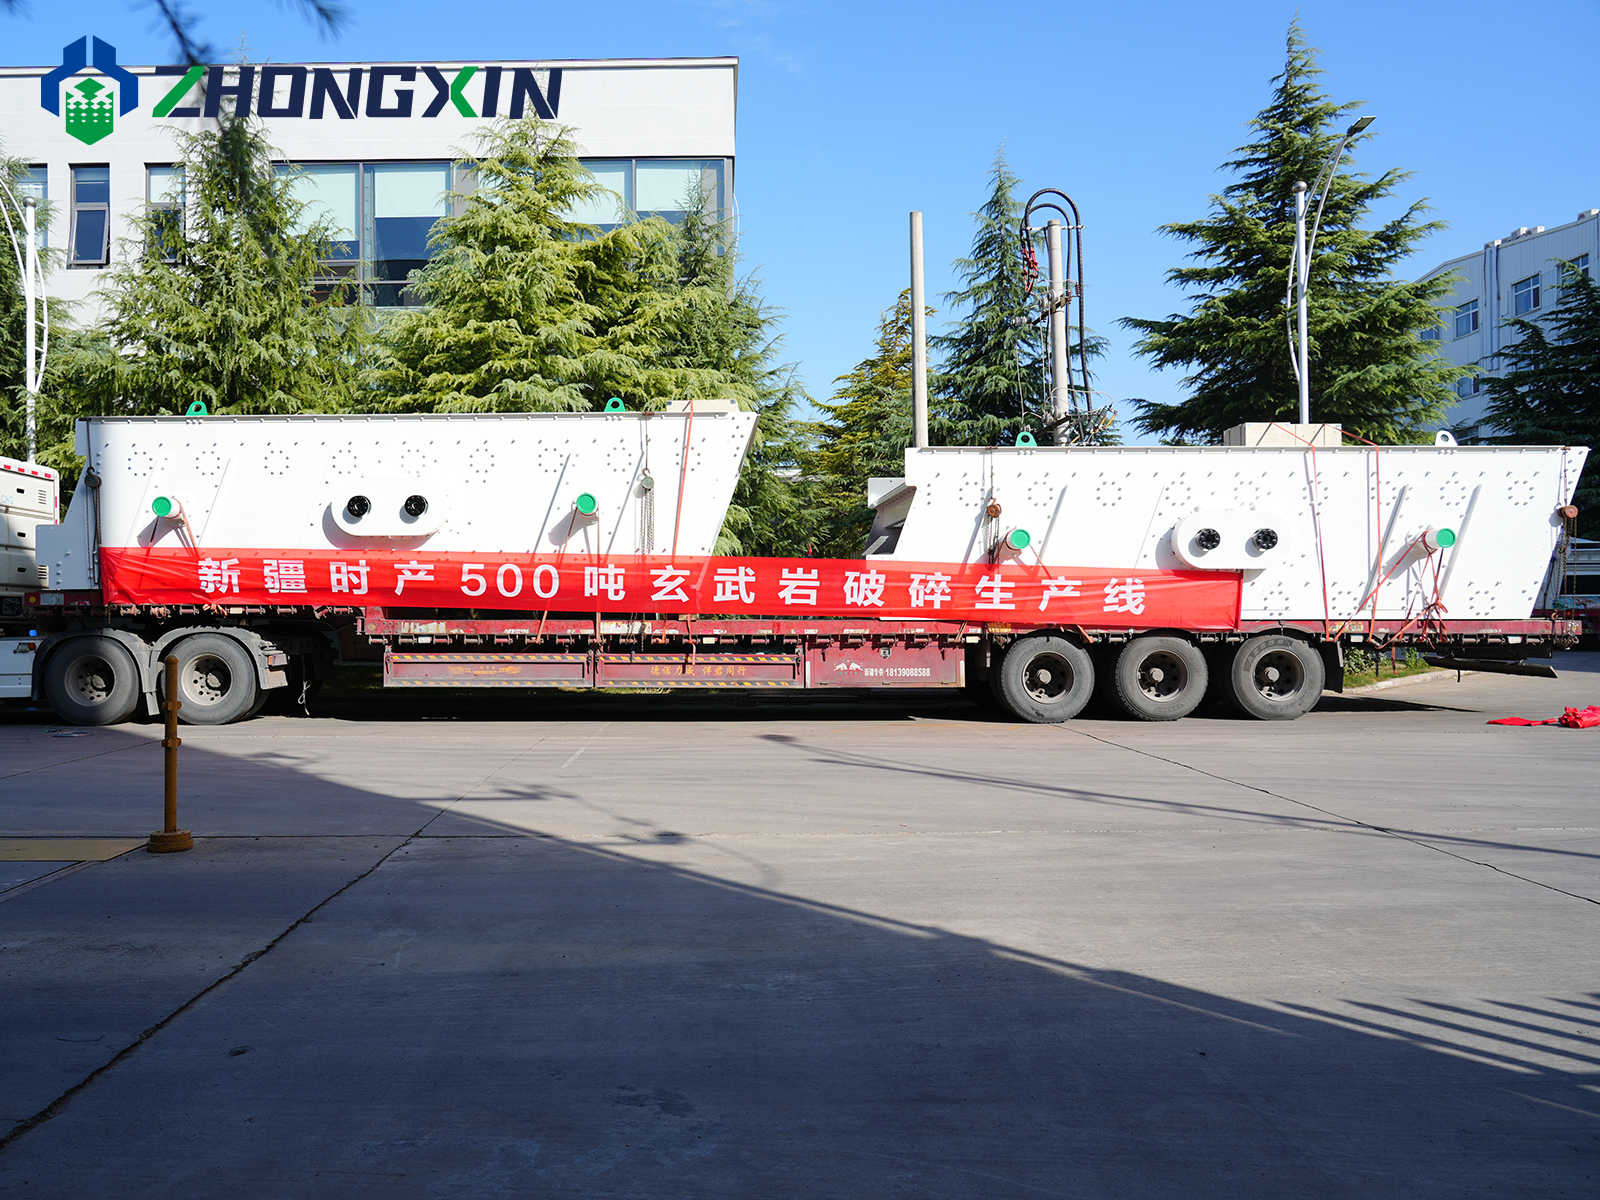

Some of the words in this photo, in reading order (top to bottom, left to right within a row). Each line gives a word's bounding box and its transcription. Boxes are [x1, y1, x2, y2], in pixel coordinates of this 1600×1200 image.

[198, 557, 1146, 616] 新疆时产500吨玄武岩破碎生产线
